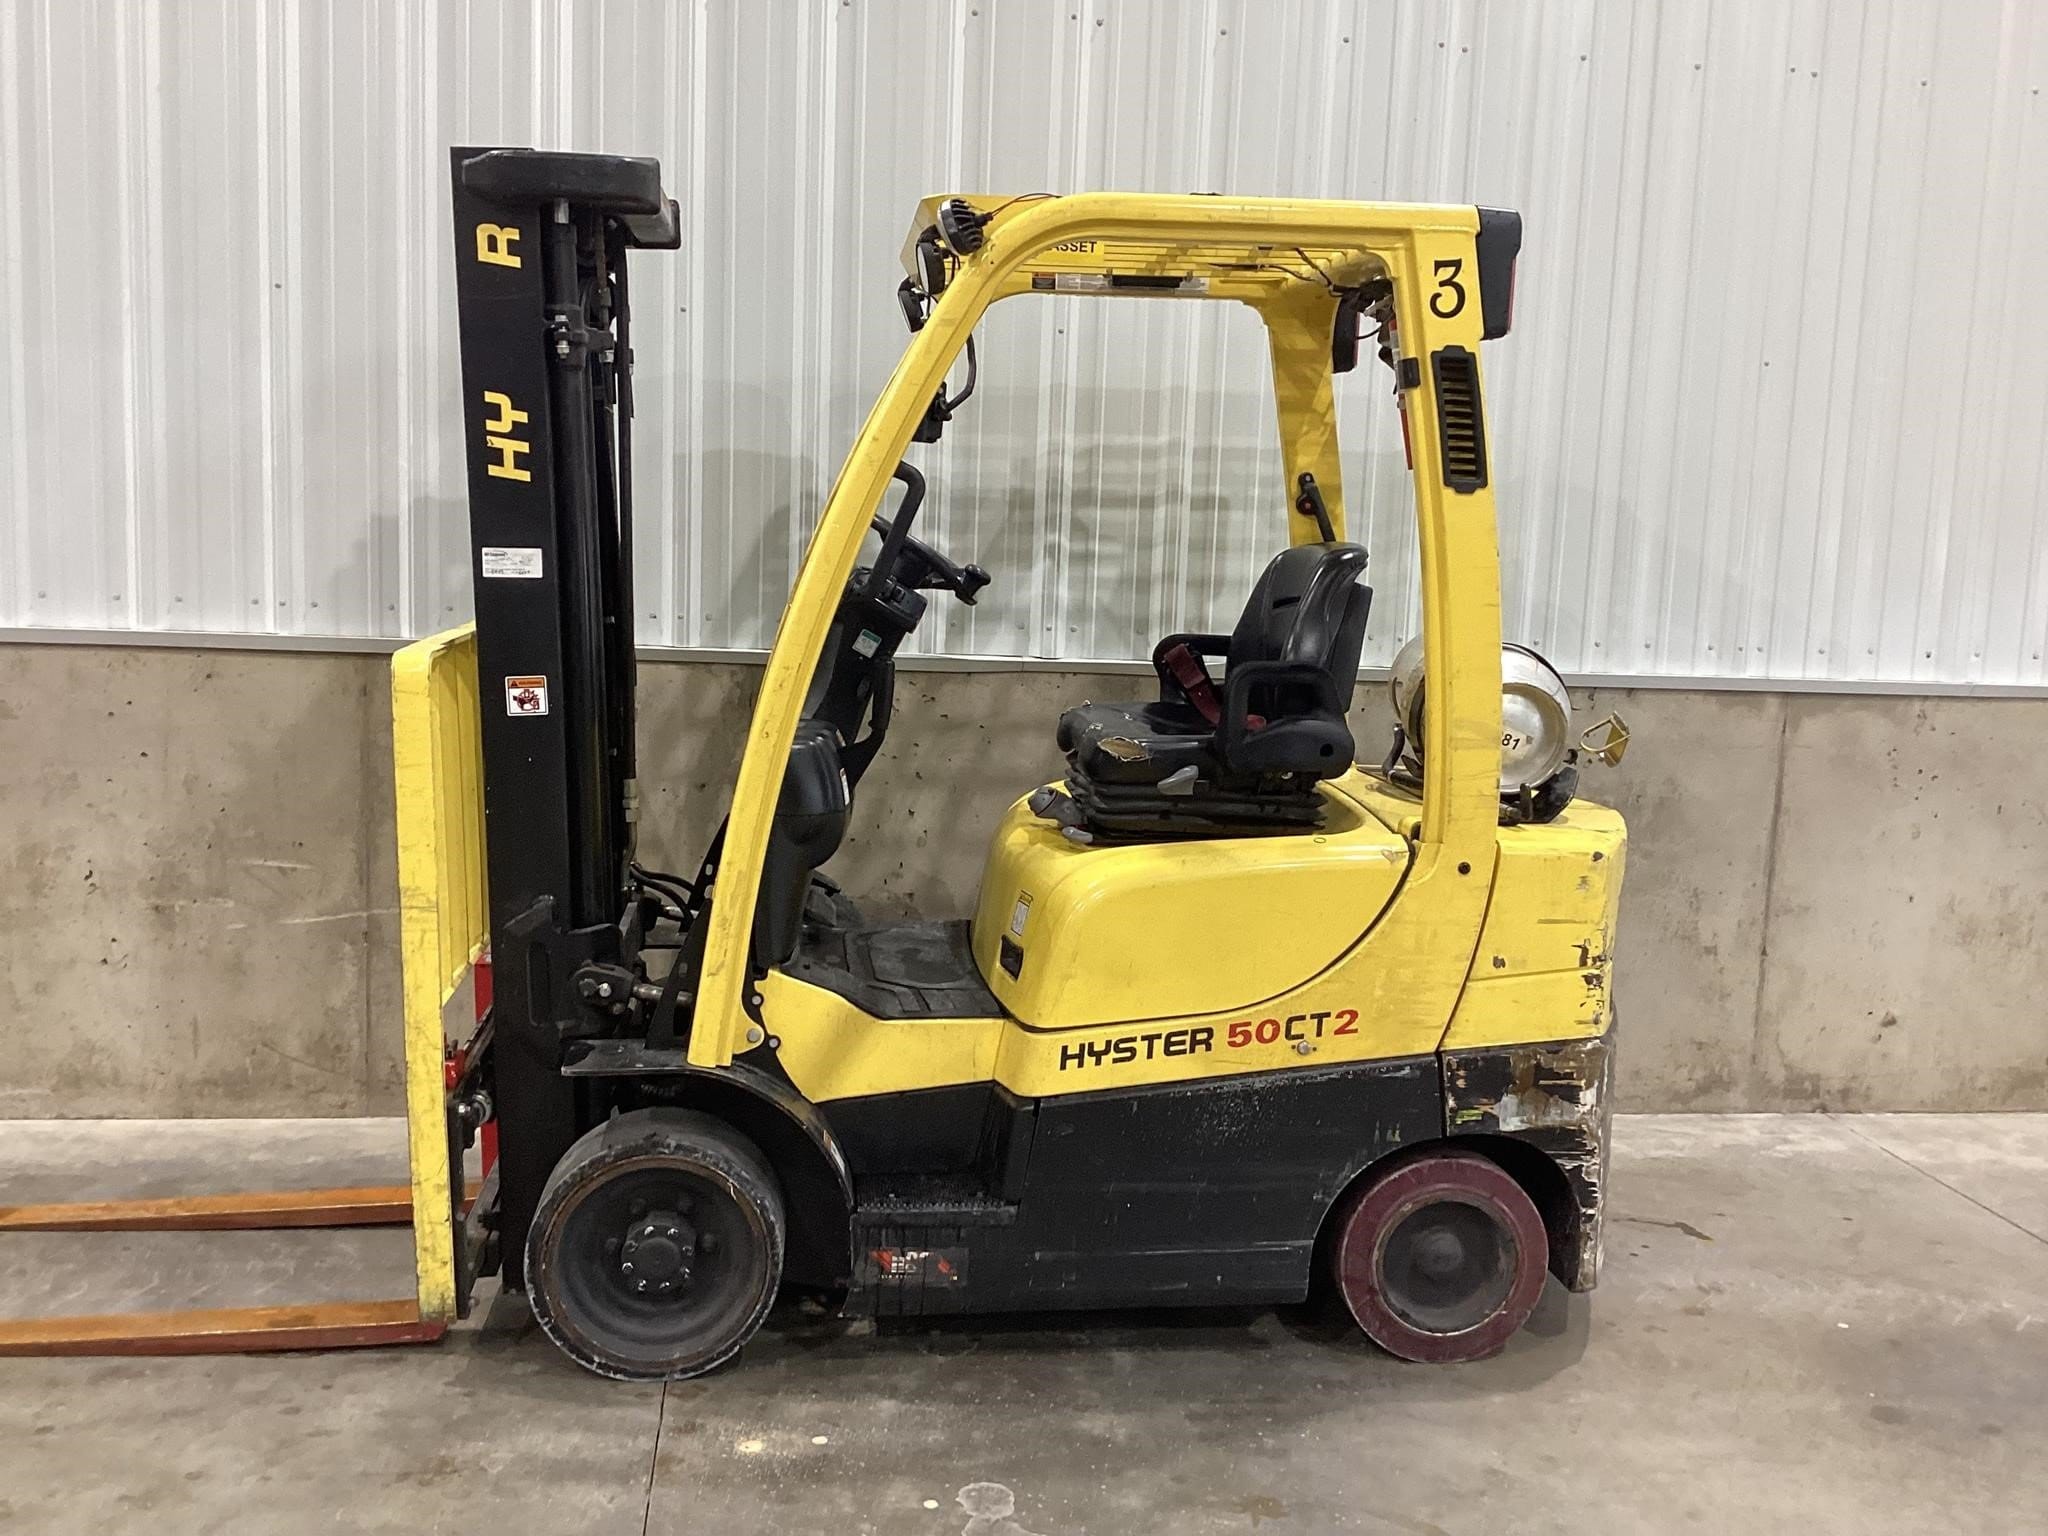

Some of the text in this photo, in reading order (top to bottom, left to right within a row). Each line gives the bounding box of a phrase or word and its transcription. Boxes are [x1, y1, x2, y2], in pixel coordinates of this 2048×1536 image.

[1429, 258, 1466, 319] 3
[1501, 733, 1520, 750] 81
[1059, 1026, 1214, 1071] HYSTER
